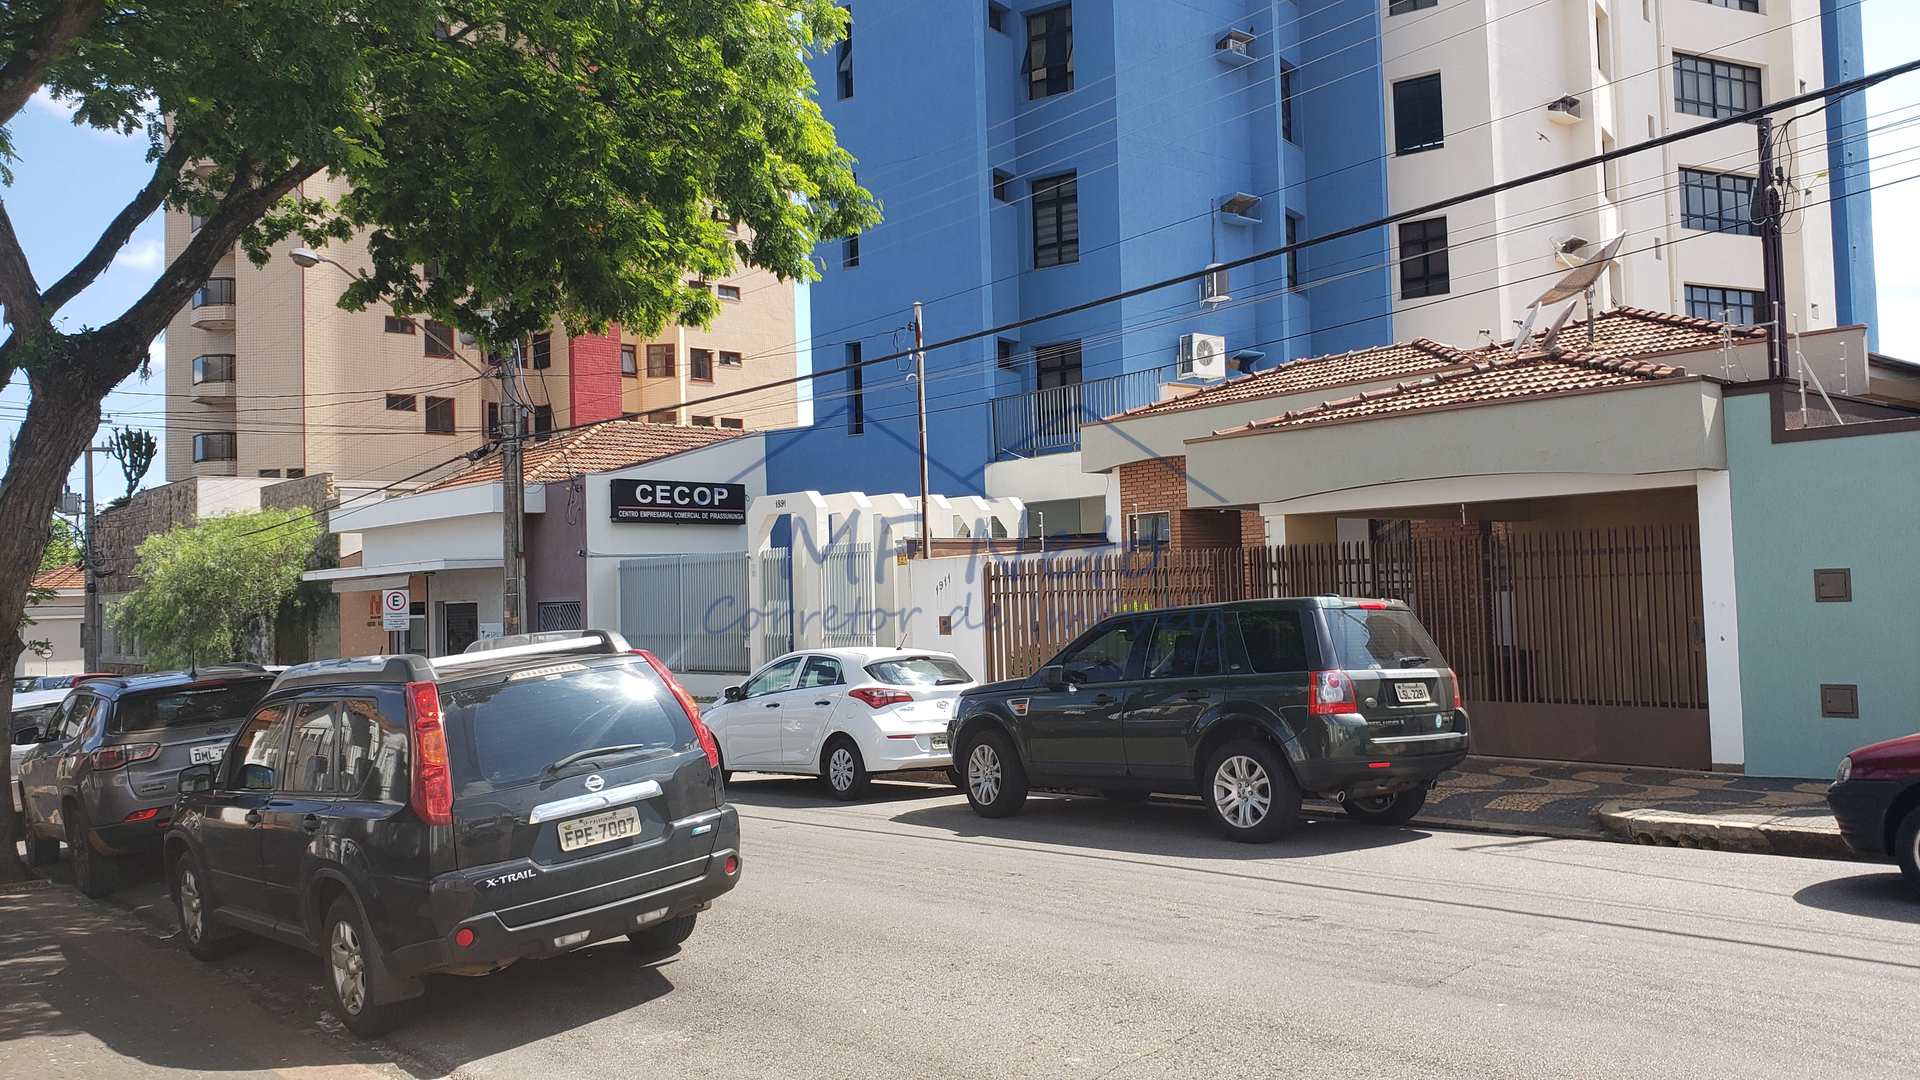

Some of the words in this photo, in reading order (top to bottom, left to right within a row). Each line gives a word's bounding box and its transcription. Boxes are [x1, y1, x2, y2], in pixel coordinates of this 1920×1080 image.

[635, 484, 729, 506] CECOP
[618, 510, 638, 518] CENTRO
[640, 511, 673, 519] EMPRESARIAL
[935, 573, 951, 597] 1911
[392, 595, 400, 607] E
[564, 817, 635, 847] FPE-7007
[486, 868, 537, 888] X-TRAIL
